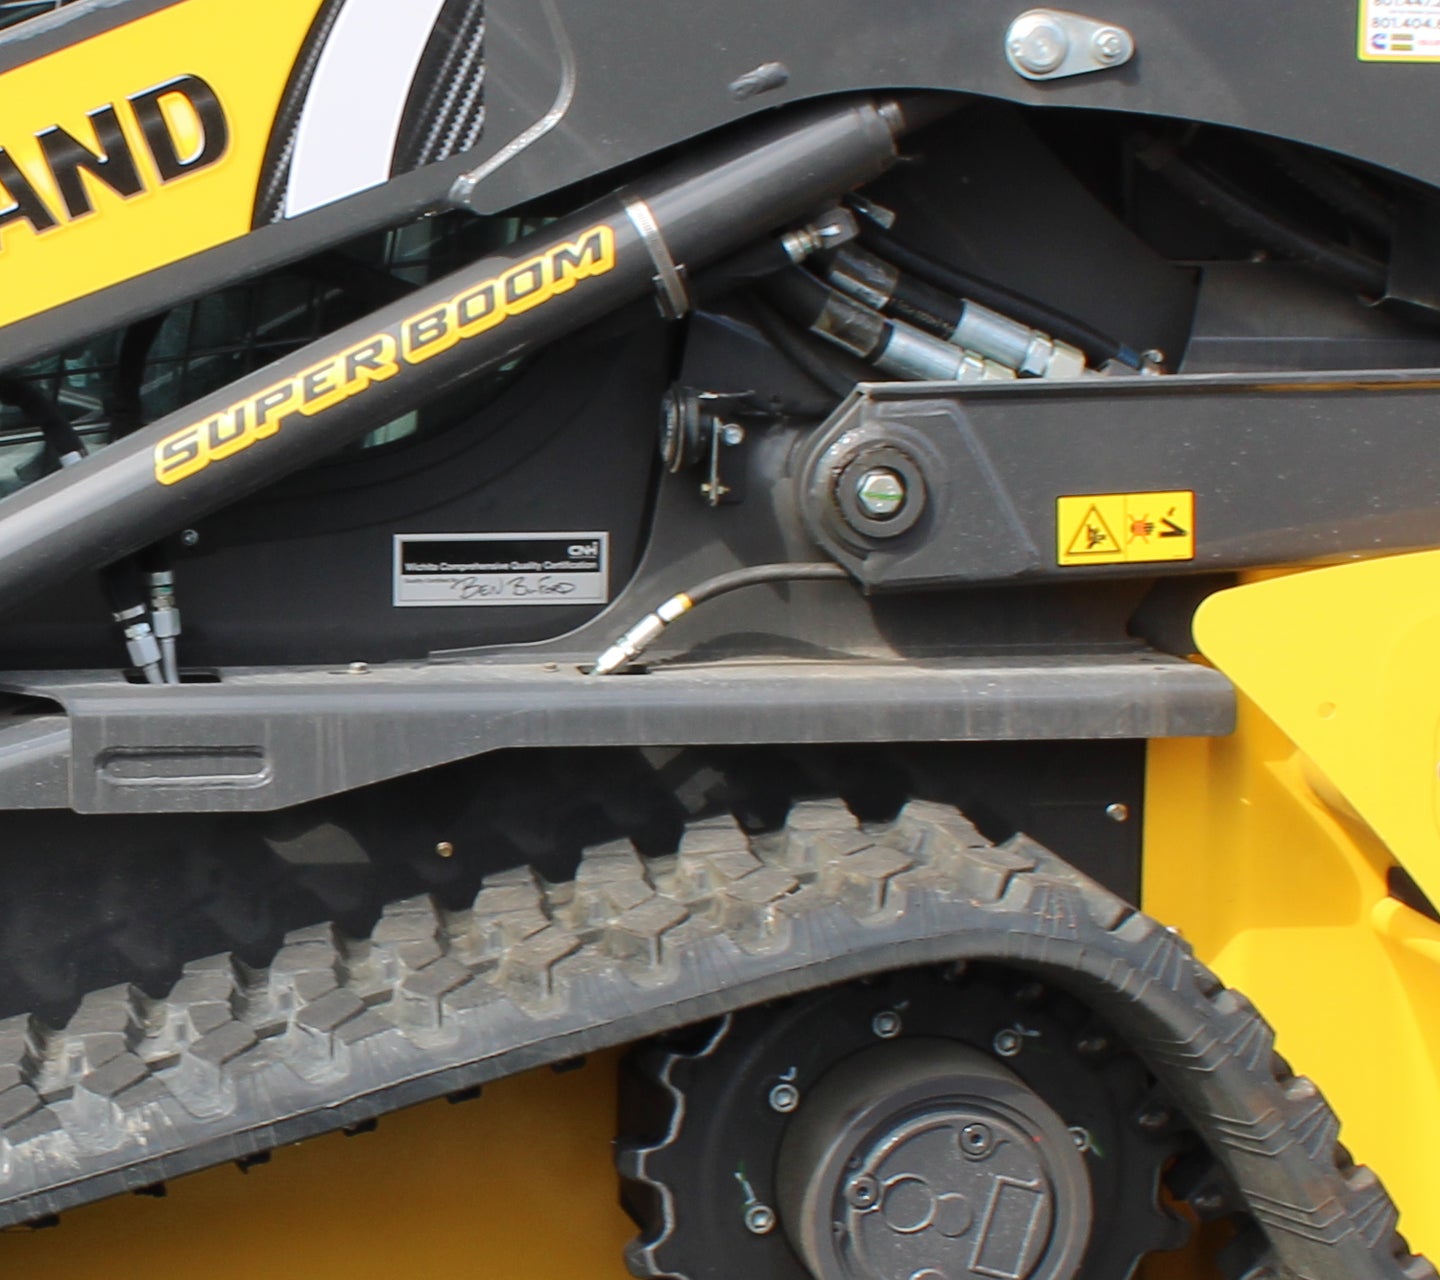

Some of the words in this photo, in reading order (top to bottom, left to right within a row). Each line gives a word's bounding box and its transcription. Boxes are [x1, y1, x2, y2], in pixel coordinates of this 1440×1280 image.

[158, 335, 397, 478] SUPER
[404, 227, 610, 360] BOOM
[440, 561, 509, 572] Comprehensive
[510, 560, 542, 571] Quality
[543, 560, 598, 570] Certification
